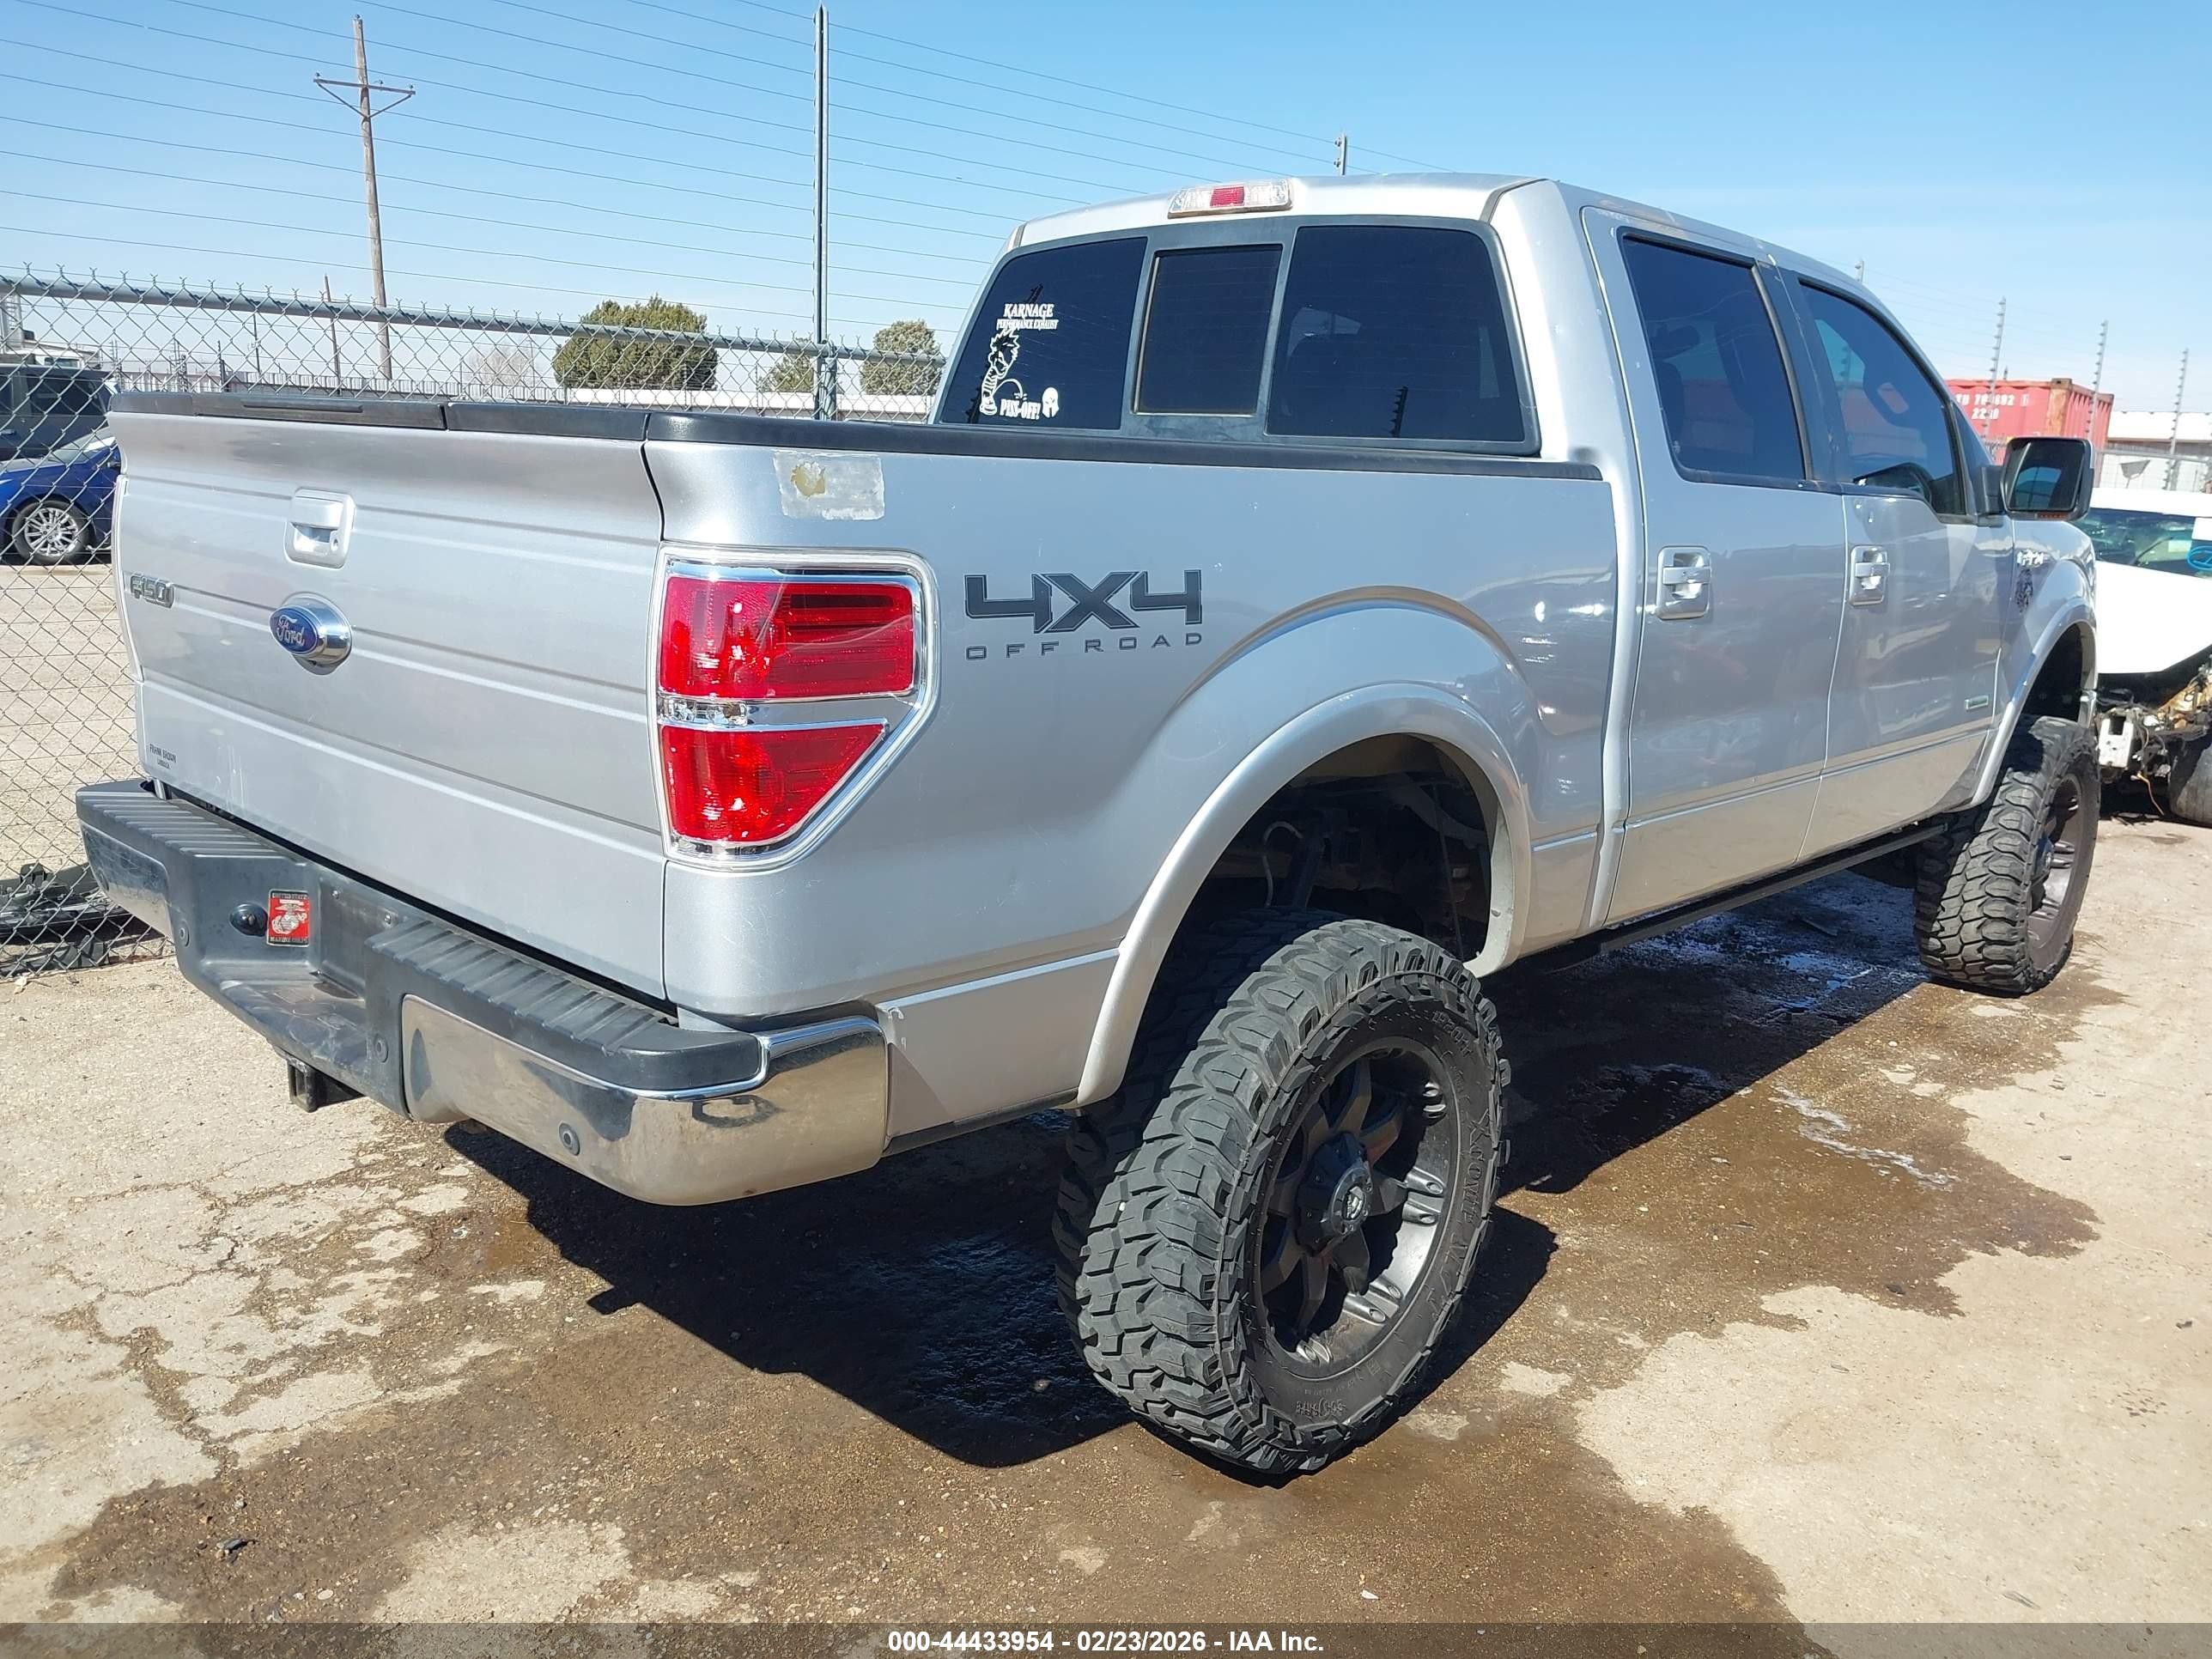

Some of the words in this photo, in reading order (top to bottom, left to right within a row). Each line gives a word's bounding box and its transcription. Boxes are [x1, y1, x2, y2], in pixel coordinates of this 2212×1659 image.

[1003, 303, 1054, 318] KARNAGE
[964, 569, 1202, 634] 4X4
[276, 613, 306, 647] Ford
[966, 641, 1060, 661] OFF
[1084, 633, 1202, 653] ROAD
[162, 750, 177, 763] BROWN
